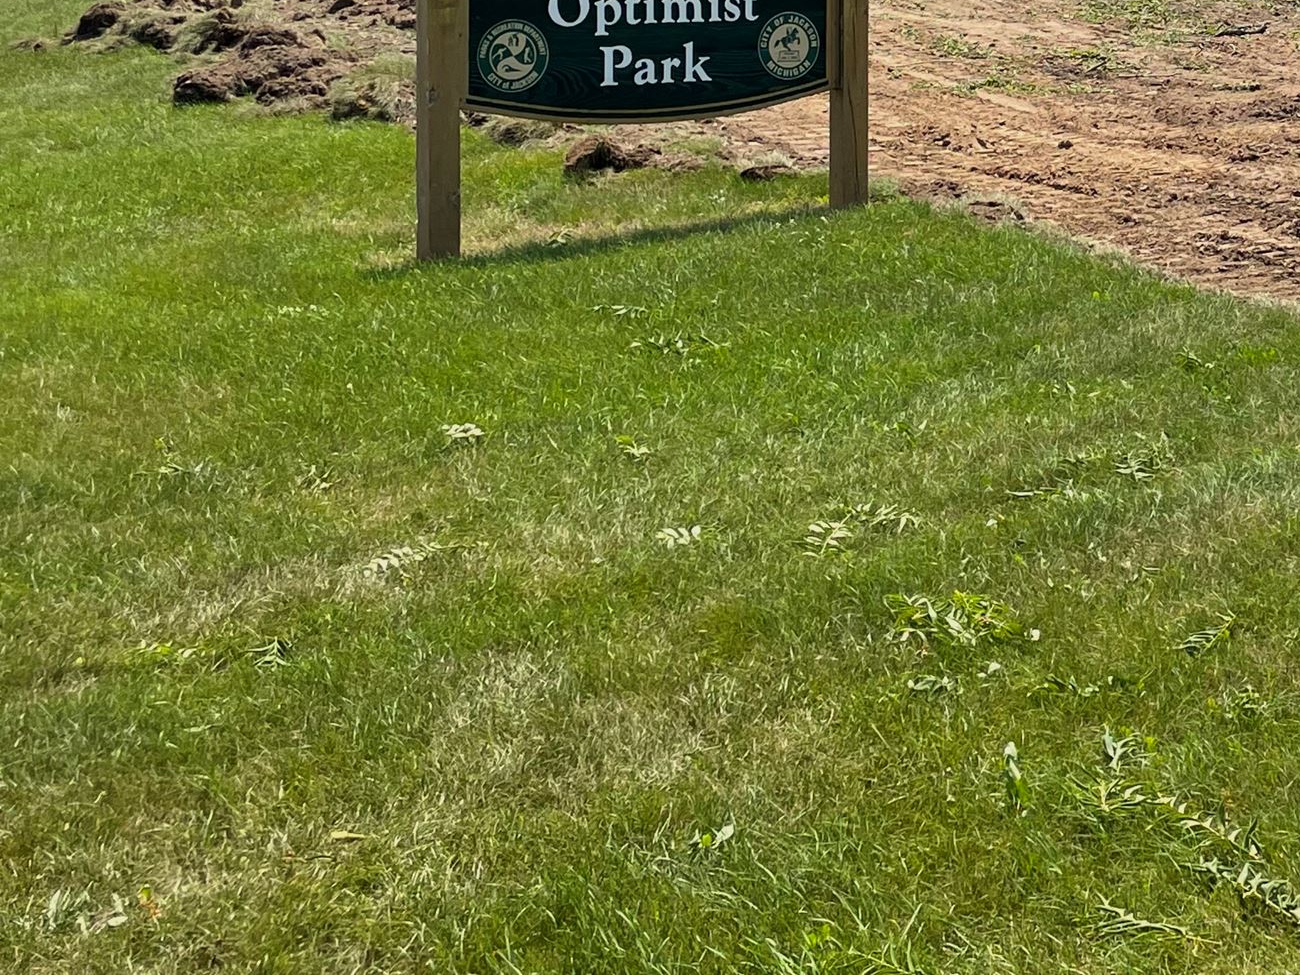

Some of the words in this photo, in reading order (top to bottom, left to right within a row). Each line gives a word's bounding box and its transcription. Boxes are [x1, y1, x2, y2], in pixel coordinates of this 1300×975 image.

[760, 25, 773, 48] CITY
[773, 16, 785, 27] OF
[788, 15, 817, 48] JACKSON
[599, 41, 713, 87] Park
[767, 59, 811, 77] MICHIGAN
[487, 72, 503, 87] CITY
[510, 70, 539, 90] JACKSON
